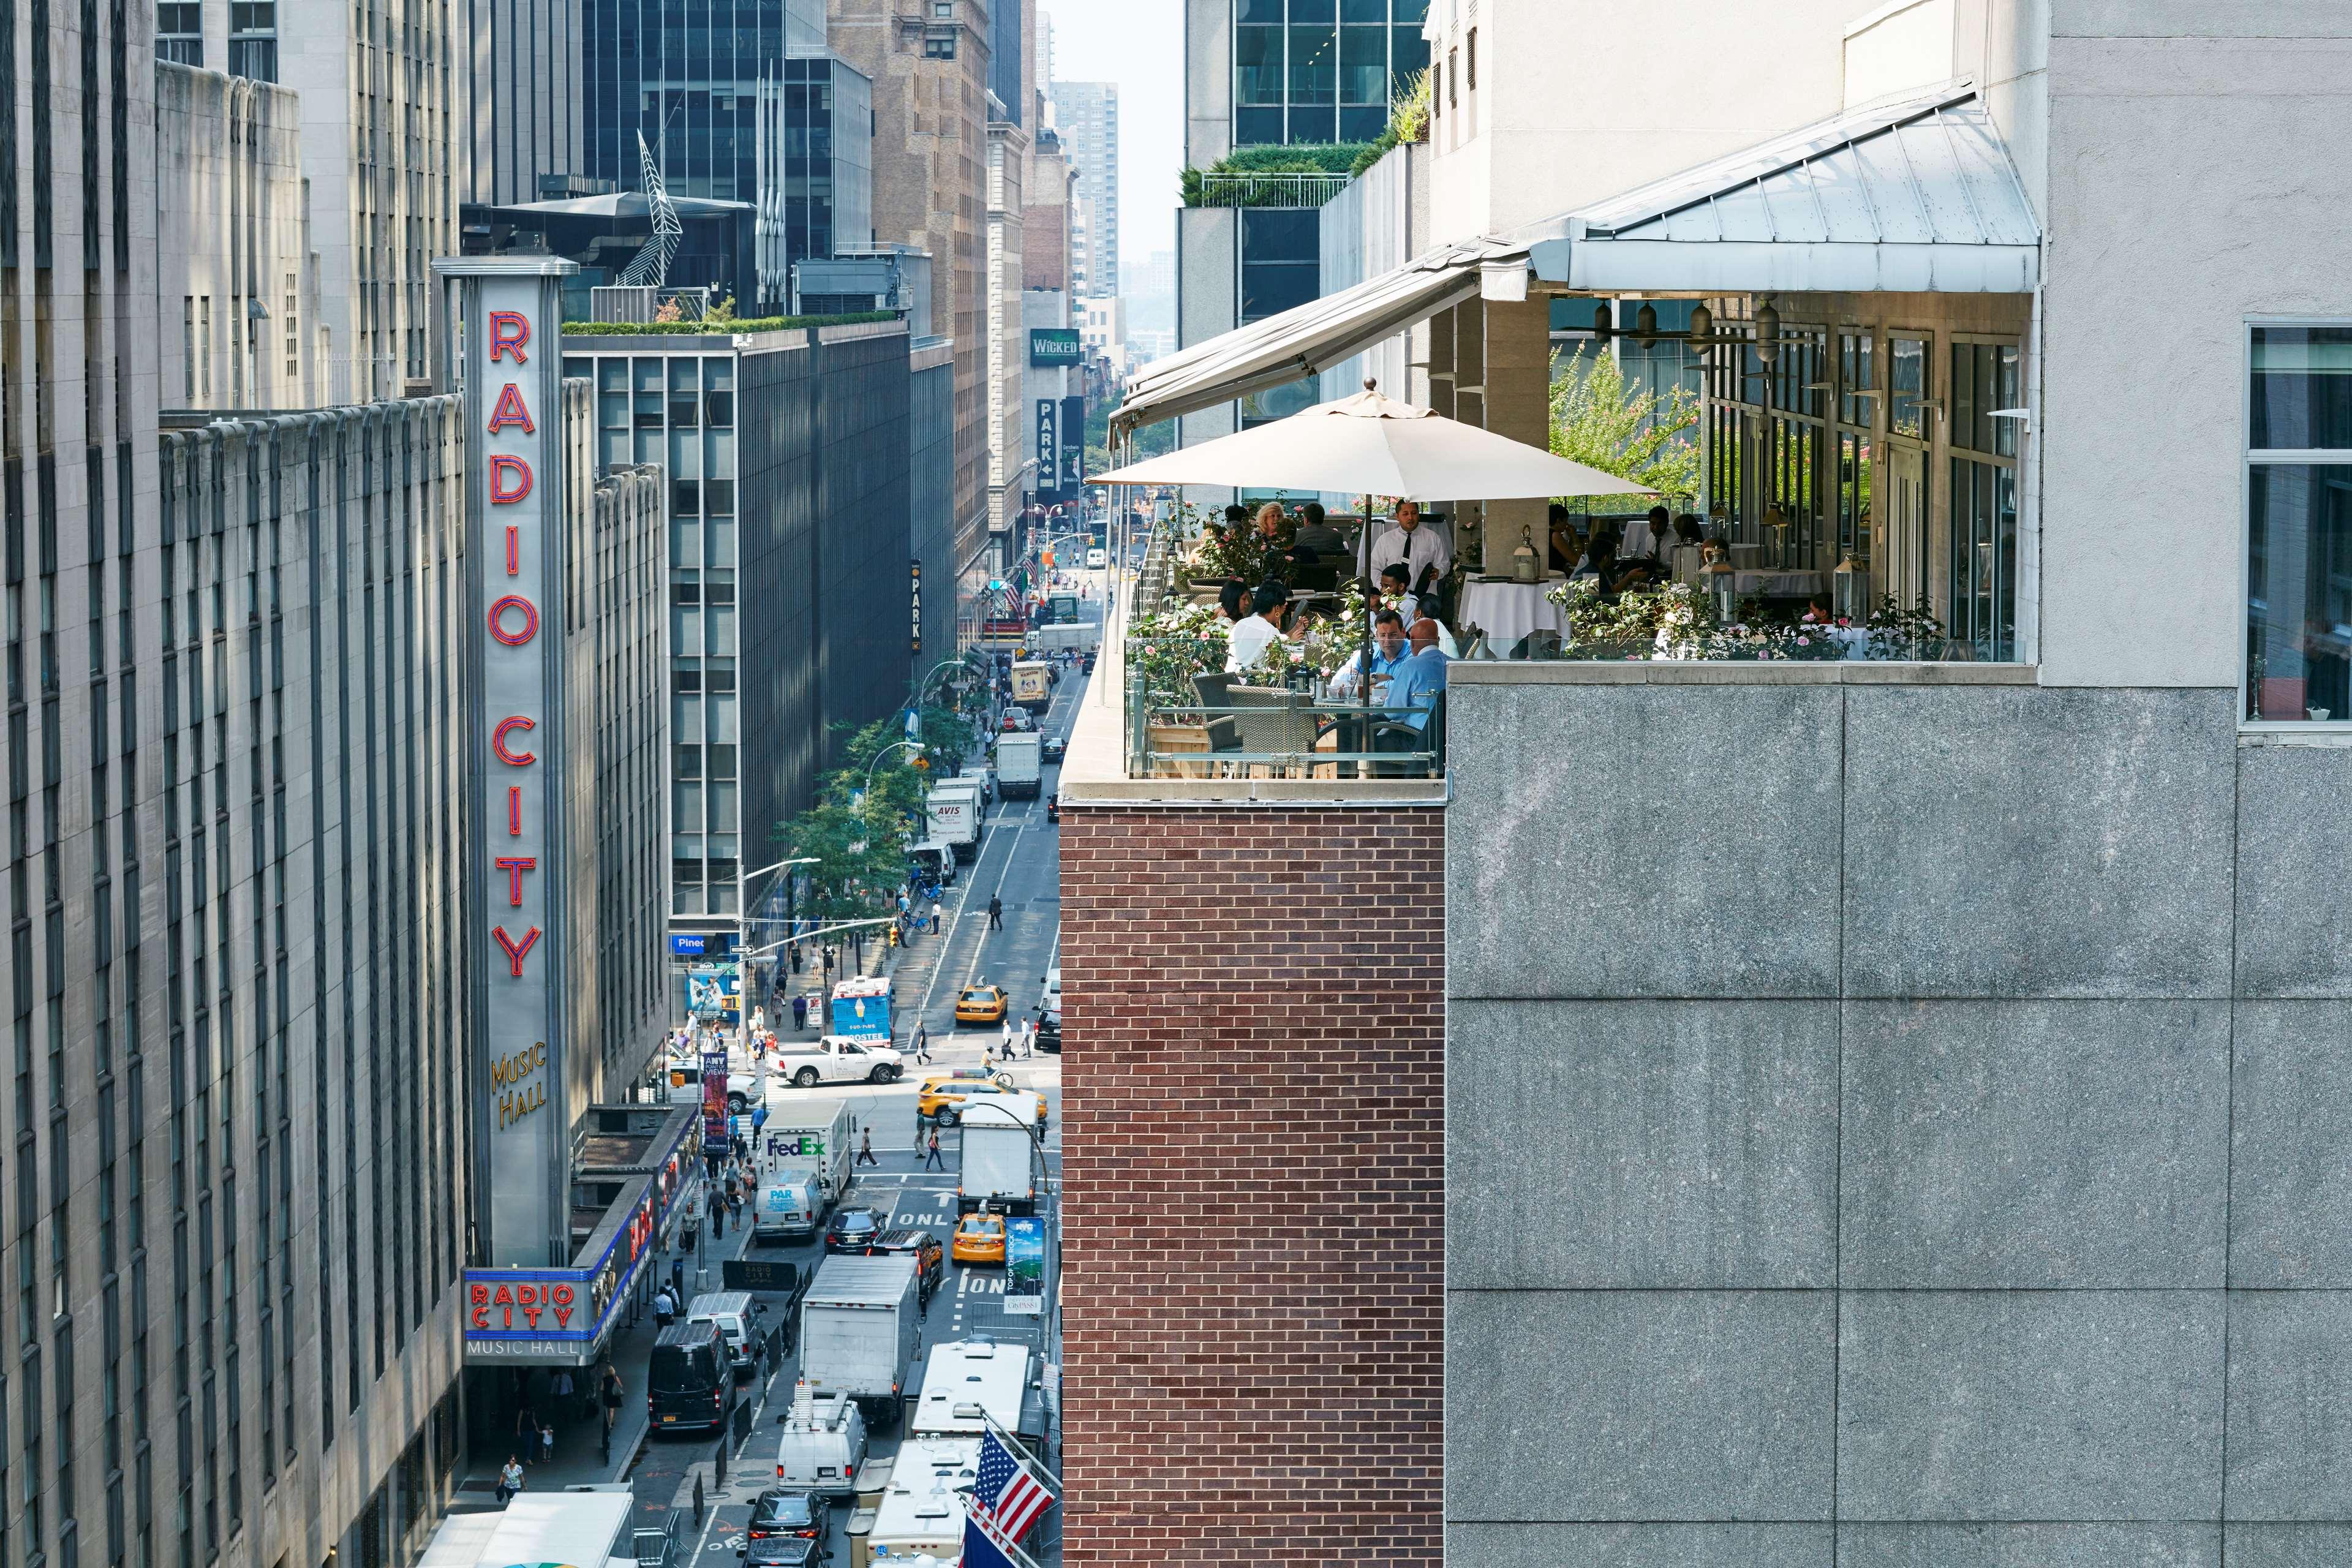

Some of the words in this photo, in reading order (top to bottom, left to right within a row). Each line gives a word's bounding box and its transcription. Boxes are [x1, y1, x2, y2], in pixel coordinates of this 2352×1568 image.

[1041, 403, 1052, 461] PARK
[488, 311, 539, 646] RADIO
[492, 715, 541, 976] CITY
[492, 1042, 545, 1094] MUSIC
[499, 1081, 546, 1130] HALL
[767, 1137, 826, 1156] FedEx
[771, 1189, 792, 1199] PAR
[899, 1213, 959, 1226] ONL
[1008, 1266, 1014, 1276] OF
[471, 1284, 575, 1305] RADIO
[970, 1278, 1006, 1294] ON
[1008, 1302, 1035, 1311] CityPASS
[472, 1307, 574, 1328] CITY
[468, 1341, 523, 1354] MUSIC
[532, 1341, 578, 1354] HALL
